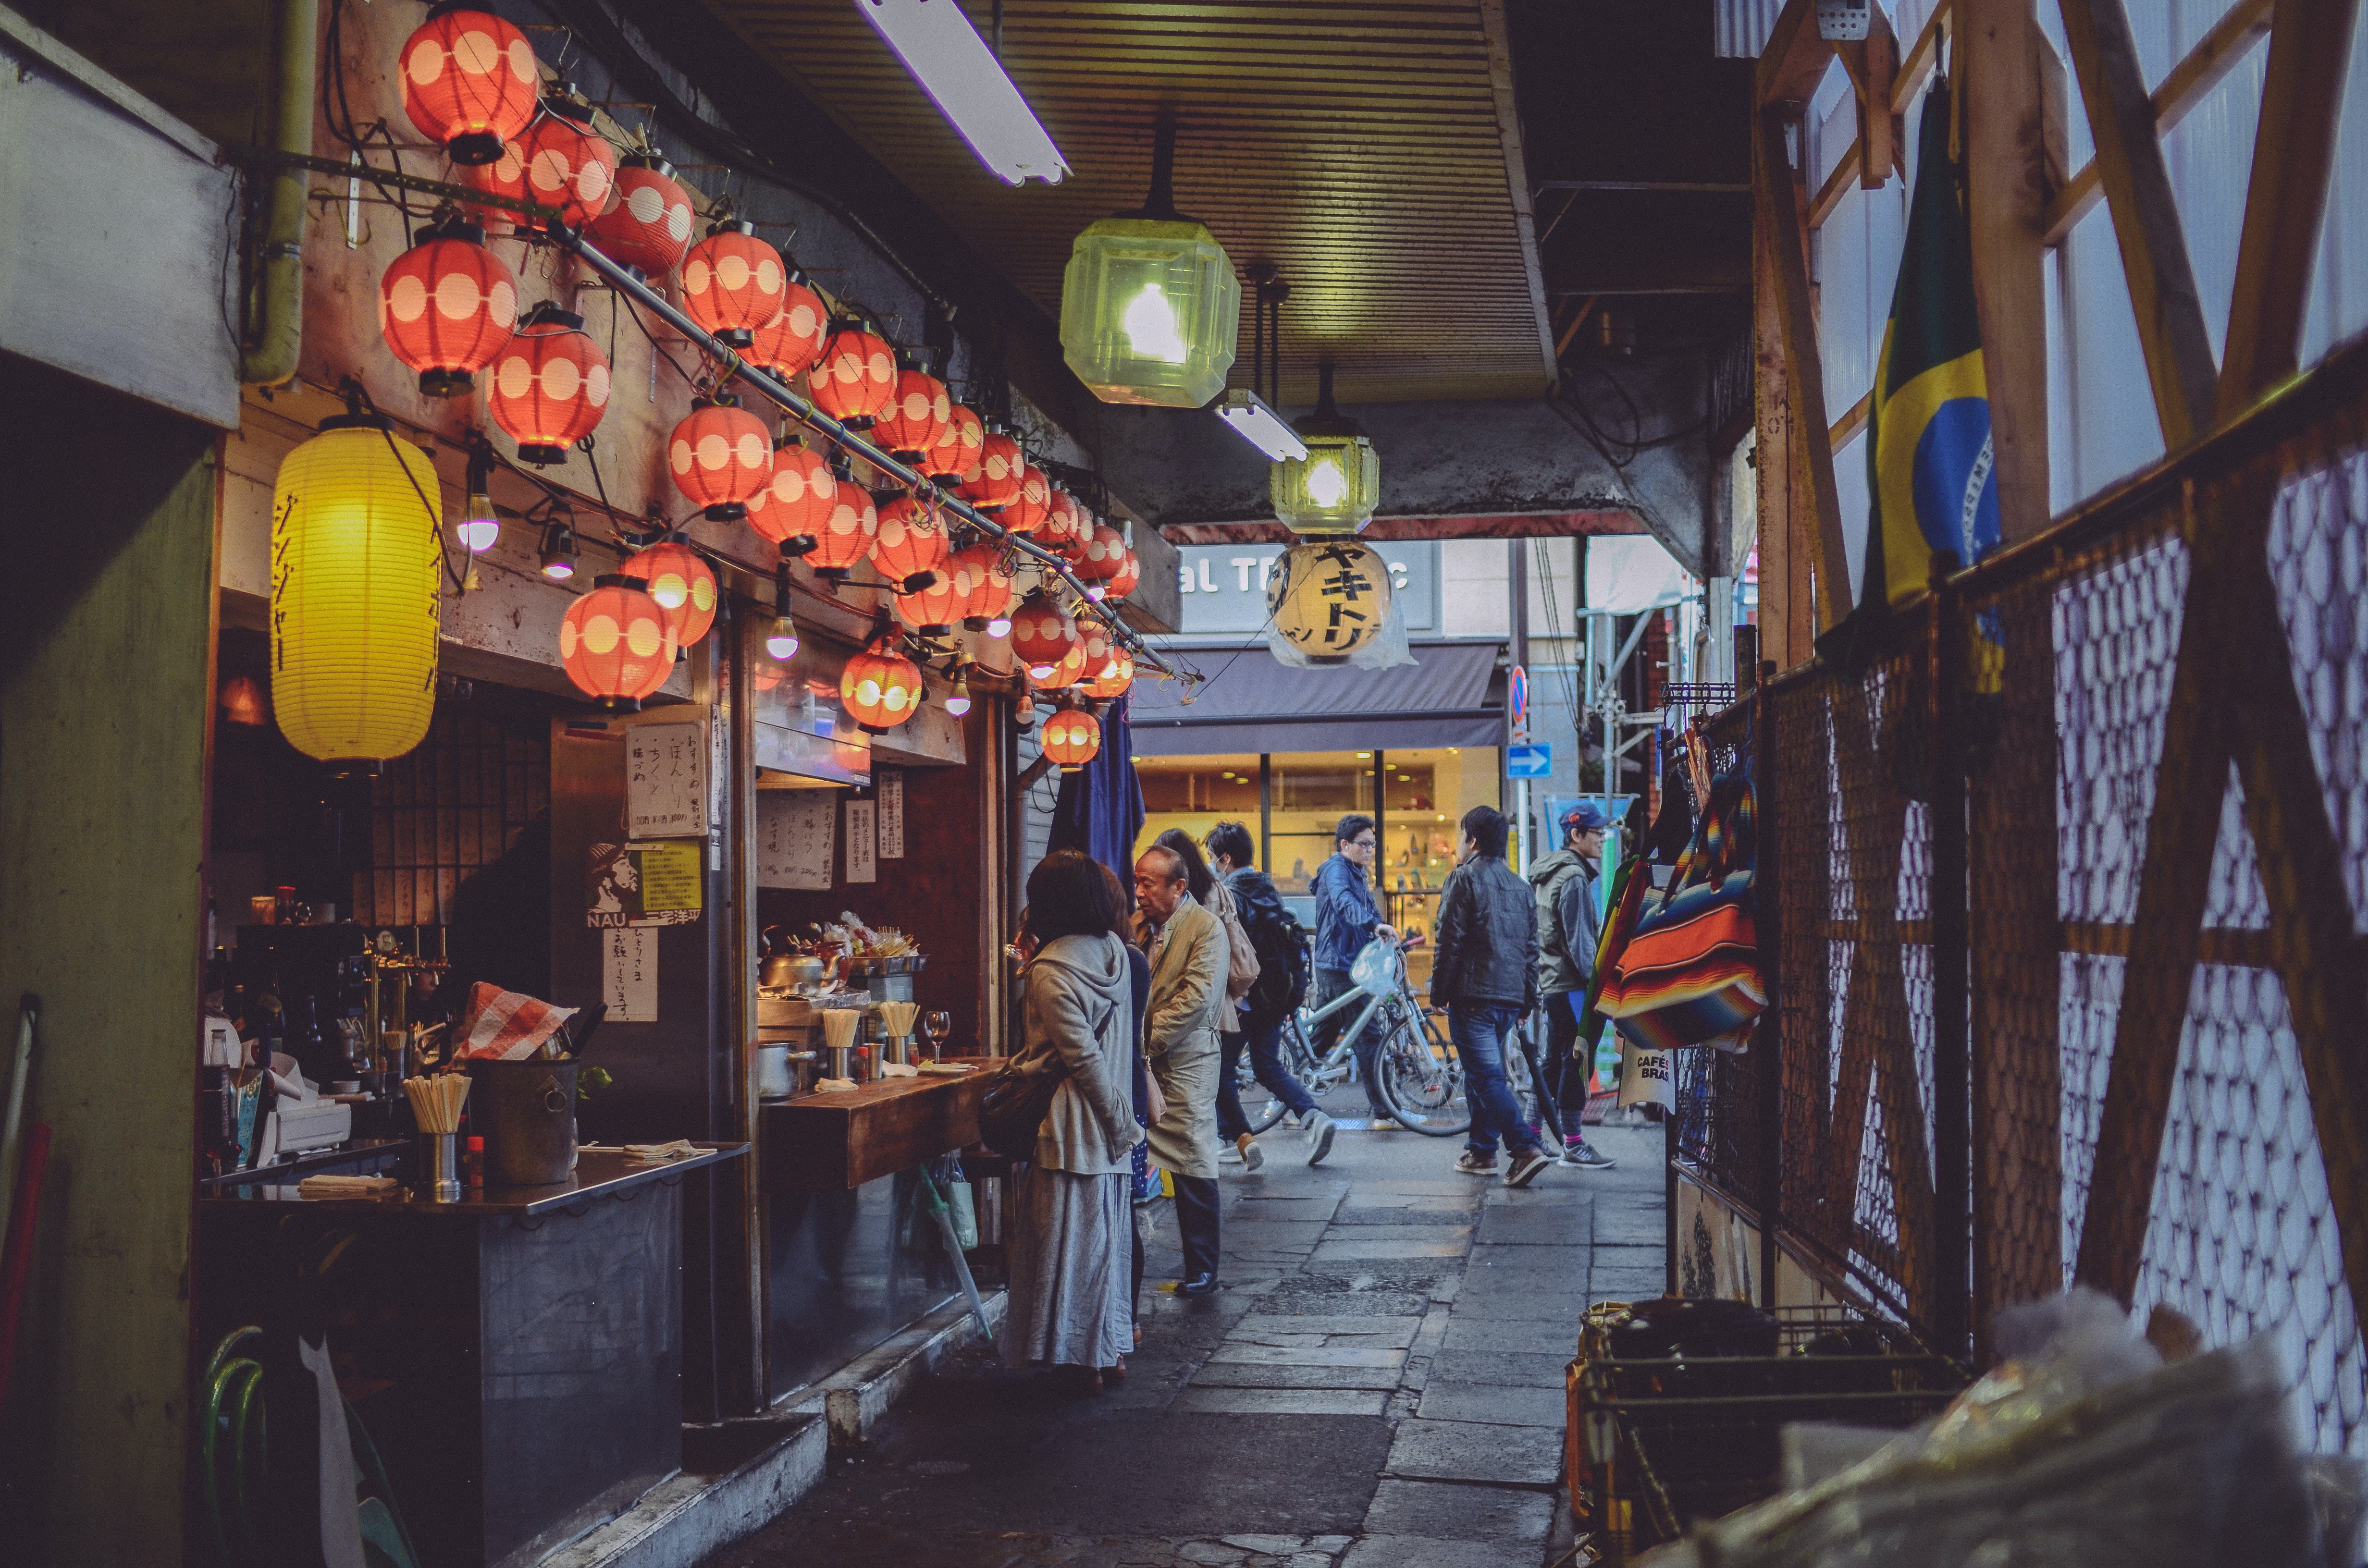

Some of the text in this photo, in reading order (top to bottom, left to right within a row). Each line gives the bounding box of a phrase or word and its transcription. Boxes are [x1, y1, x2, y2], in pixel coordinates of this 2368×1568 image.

[1315, 546, 1372, 651] ヤキトリ
[587, 913, 626, 928] NAU
